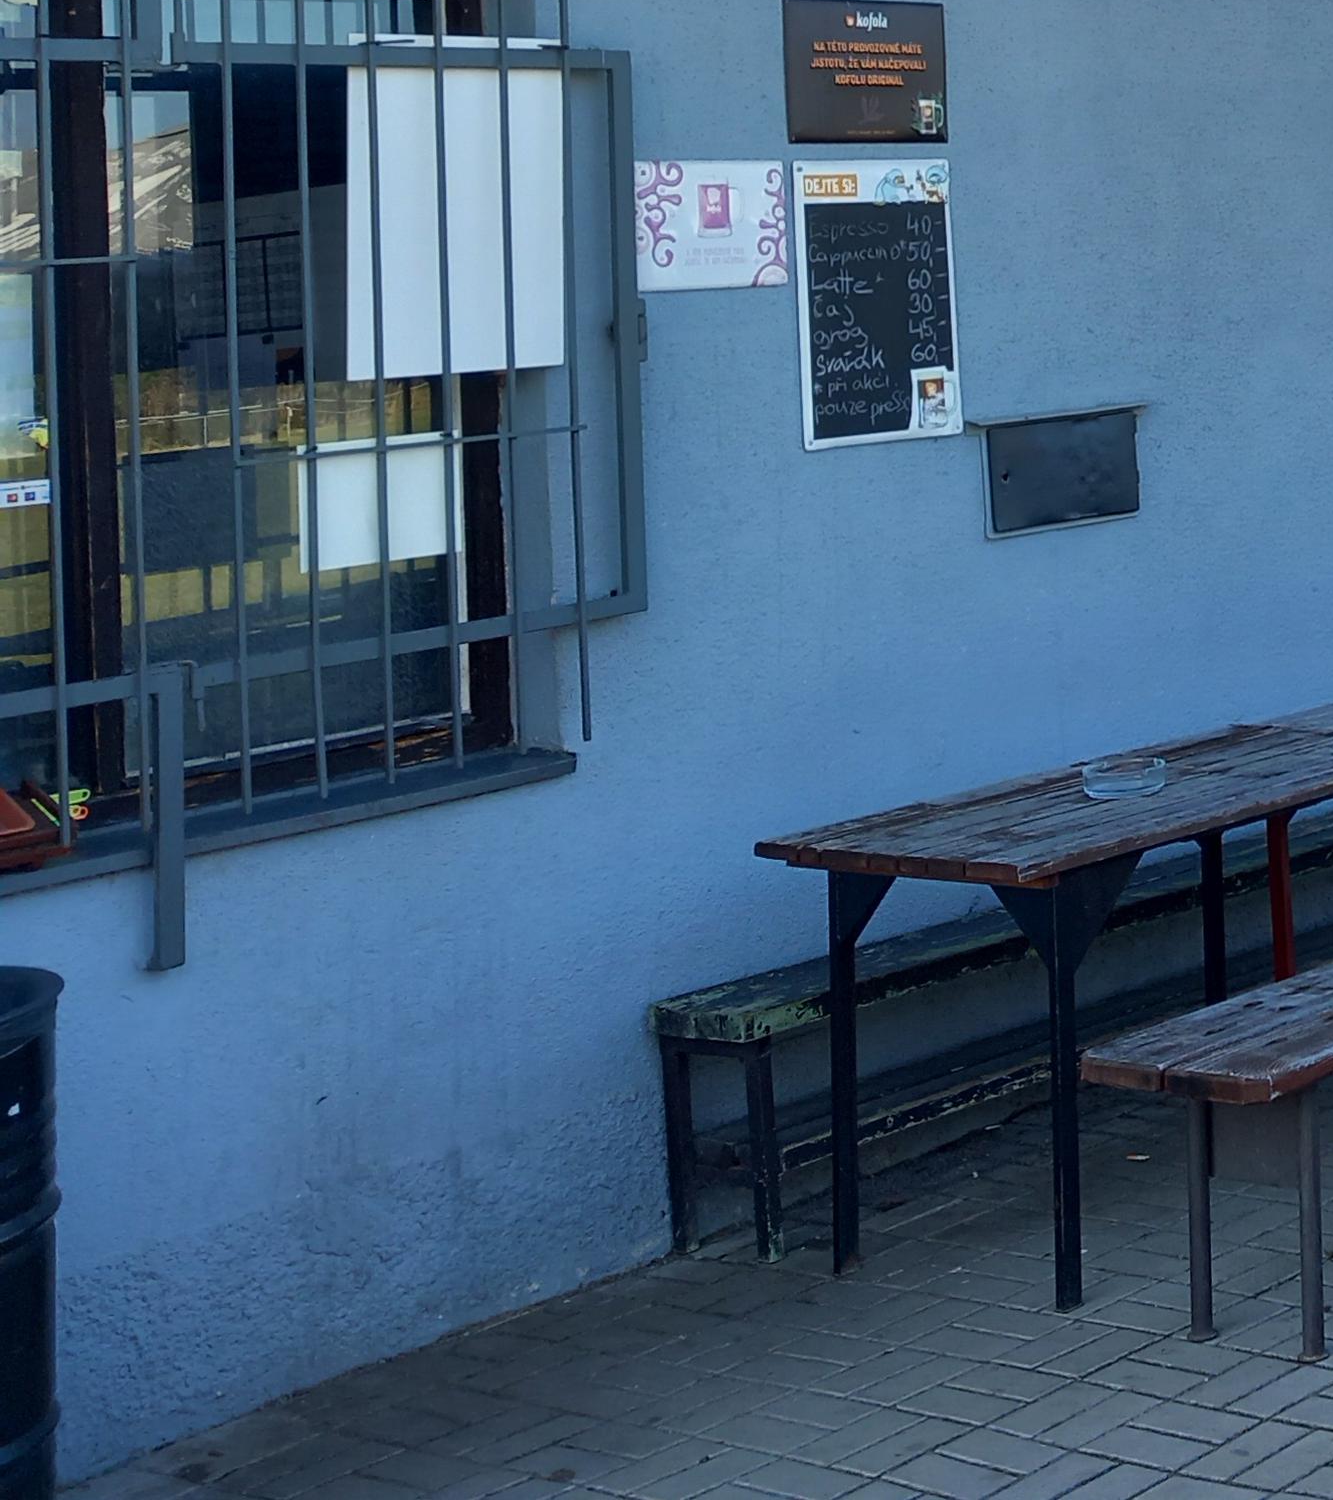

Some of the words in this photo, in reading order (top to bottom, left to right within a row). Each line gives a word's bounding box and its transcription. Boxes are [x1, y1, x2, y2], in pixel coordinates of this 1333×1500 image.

[856, 11, 888, 31] kofola
[835, 74, 866, 86] KOFOLU
[804, 177, 840, 195] DEJTE
